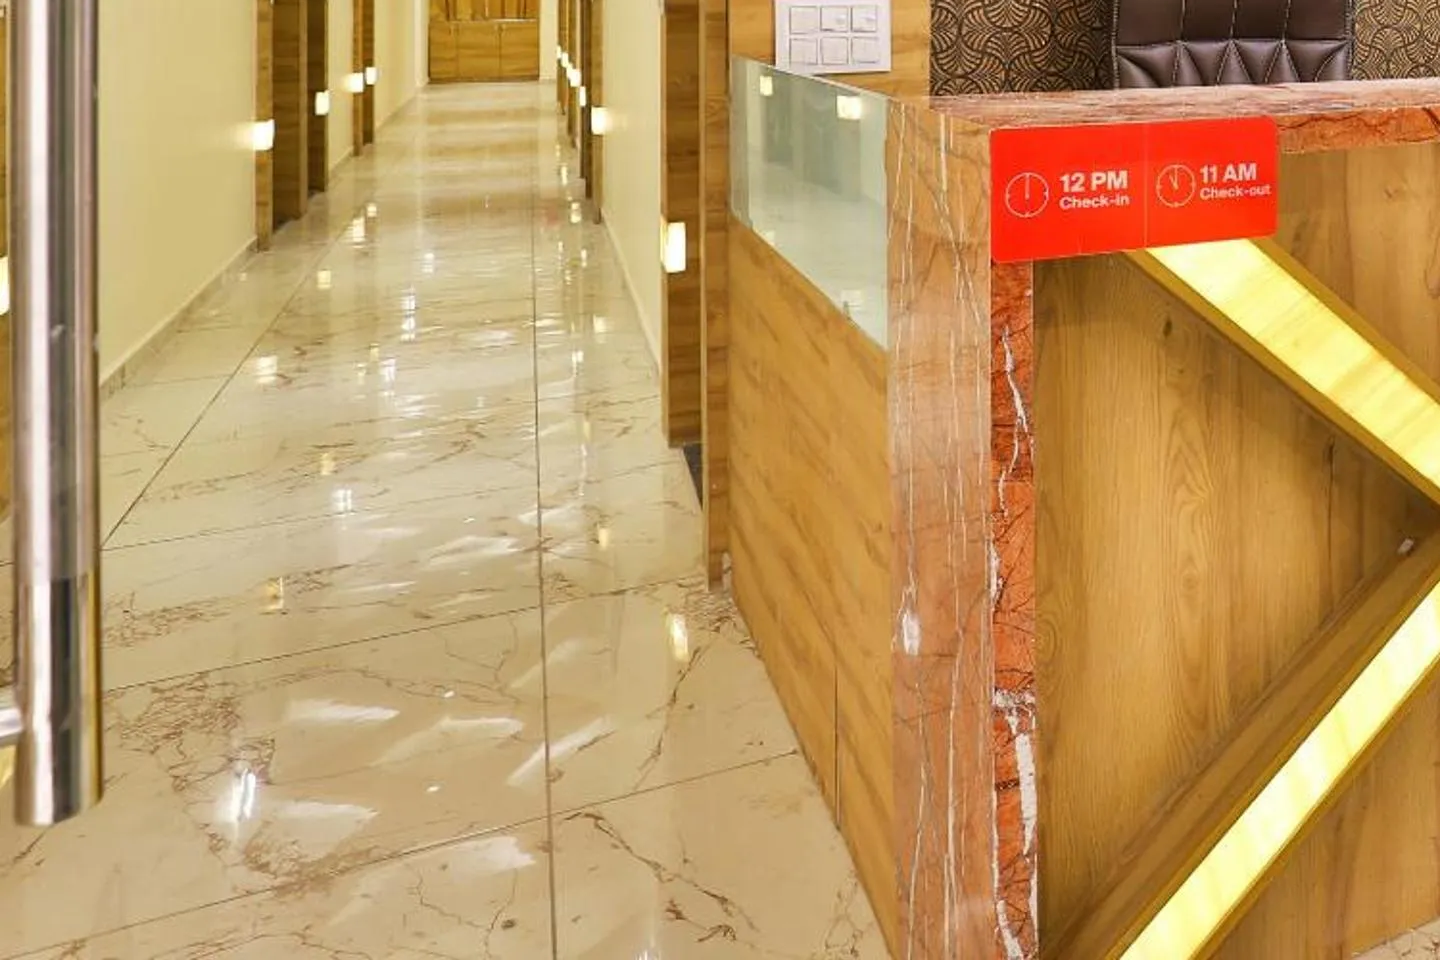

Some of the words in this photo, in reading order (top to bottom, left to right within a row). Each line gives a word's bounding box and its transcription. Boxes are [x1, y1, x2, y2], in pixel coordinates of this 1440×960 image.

[1060, 172, 1085, 193] 12
[1091, 169, 1129, 192] PM
[1200, 164, 1218, 184] 11
[1222, 162, 1257, 183] AM
[1059, 193, 1130, 210] Check-in
[1200, 184, 1271, 200] Check-out
